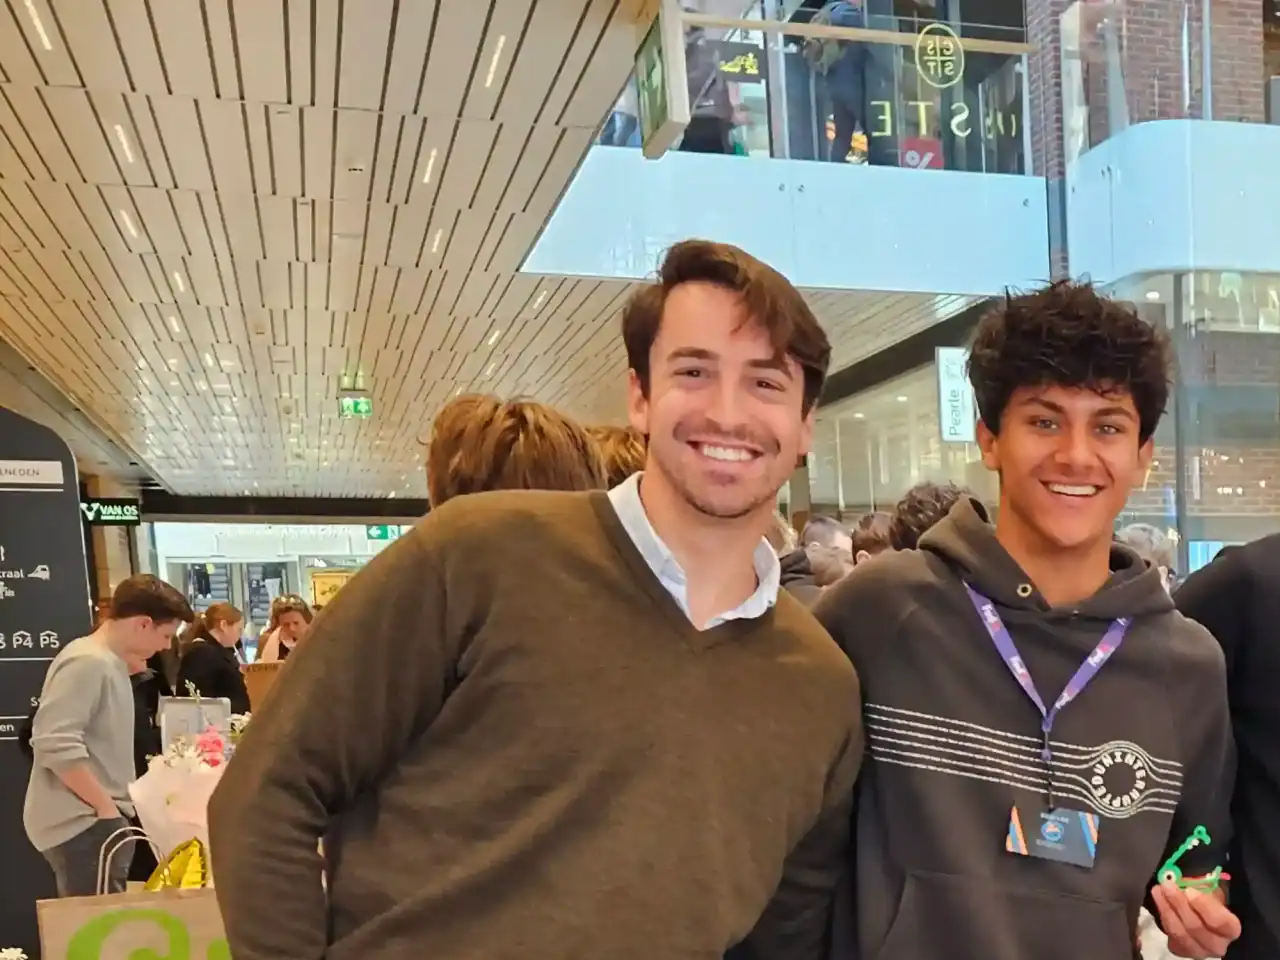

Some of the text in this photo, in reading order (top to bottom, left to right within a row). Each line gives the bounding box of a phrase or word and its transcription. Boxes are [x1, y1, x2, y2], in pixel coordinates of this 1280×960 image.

[947, 388, 962, 436] Pearle
[100, 504, 139, 516] VAN OS
[13, 632, 34, 649] P4
[40, 632, 60, 649] P5
